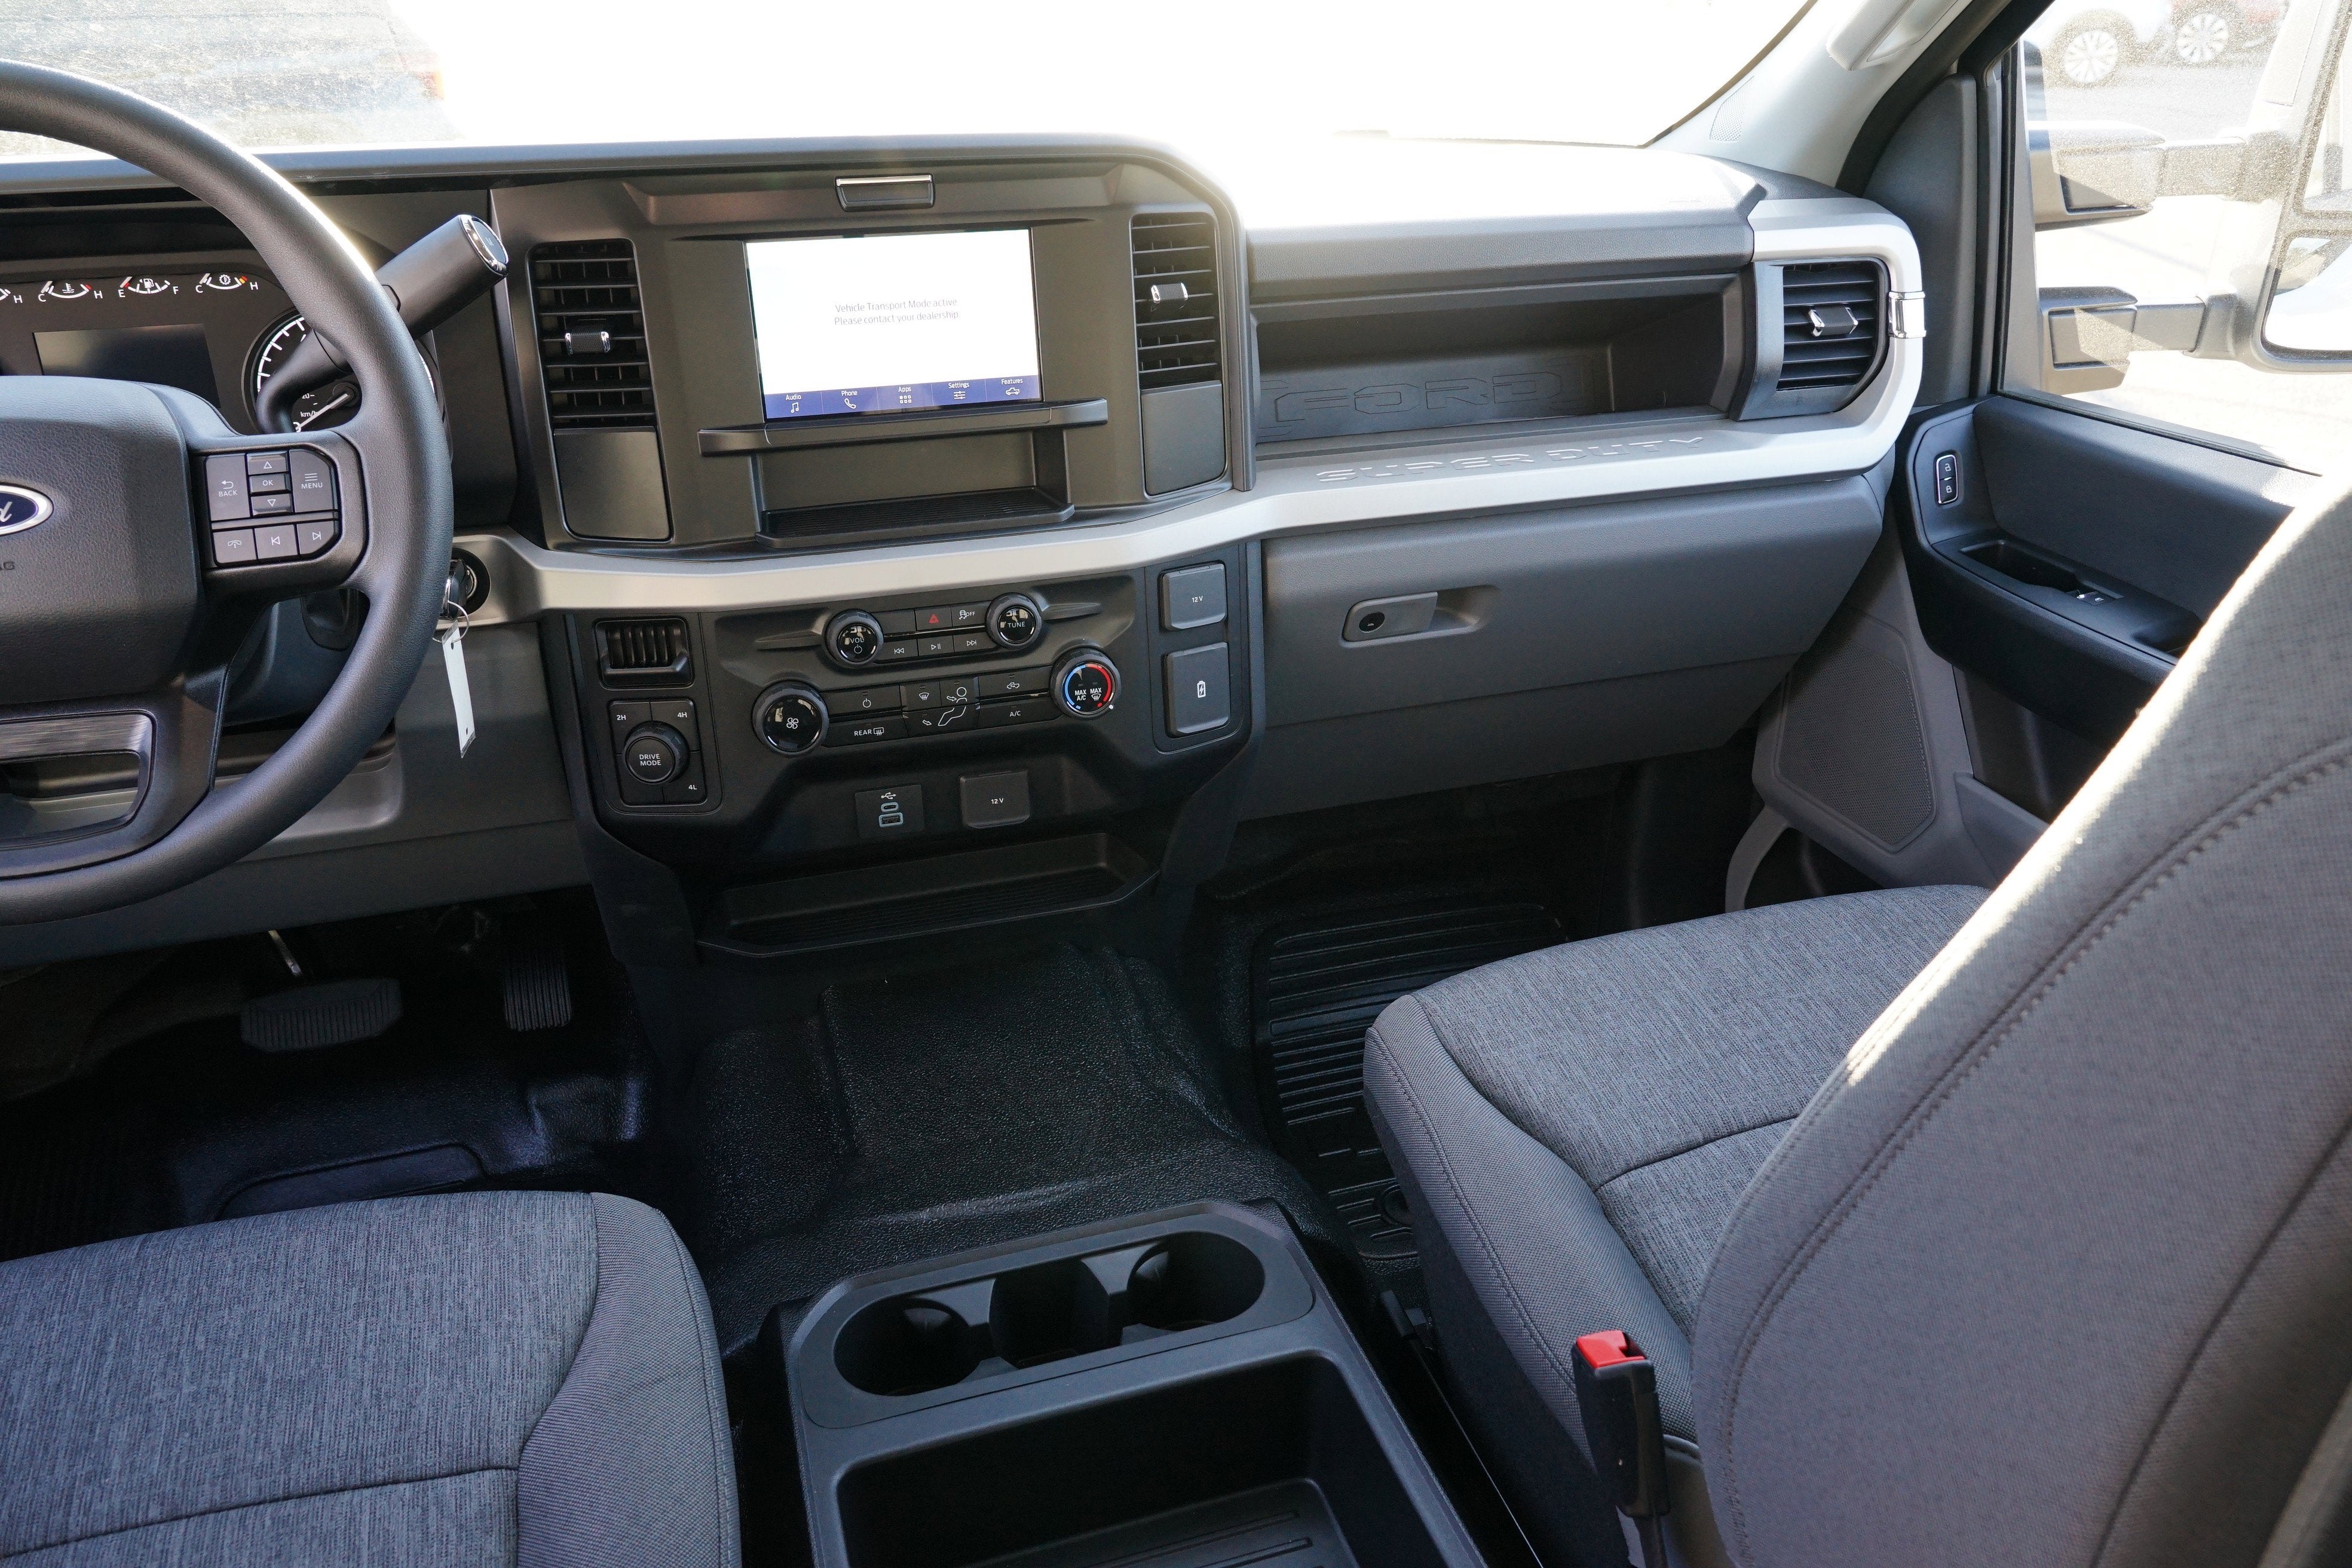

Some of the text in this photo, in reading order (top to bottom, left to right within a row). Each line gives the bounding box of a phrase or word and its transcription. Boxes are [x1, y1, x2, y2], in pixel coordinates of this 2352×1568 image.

[195, 284, 204, 293] C
[250, 281, 259, 290] H
[94, 290, 103, 299] H
[118, 289, 125, 298] E
[172, 286, 179, 295] F
[13, 295, 23, 304] H
[38, 293, 47, 302] C
[835, 298, 957, 313] Vehicle Transport Mode active
[834, 316, 862, 325] Please
[864, 314, 895, 324] contact
[896, 314, 914, 323] your
[1275, 371, 1562, 422] FORD
[1315, 436, 1704, 482] SUPER DUTY
